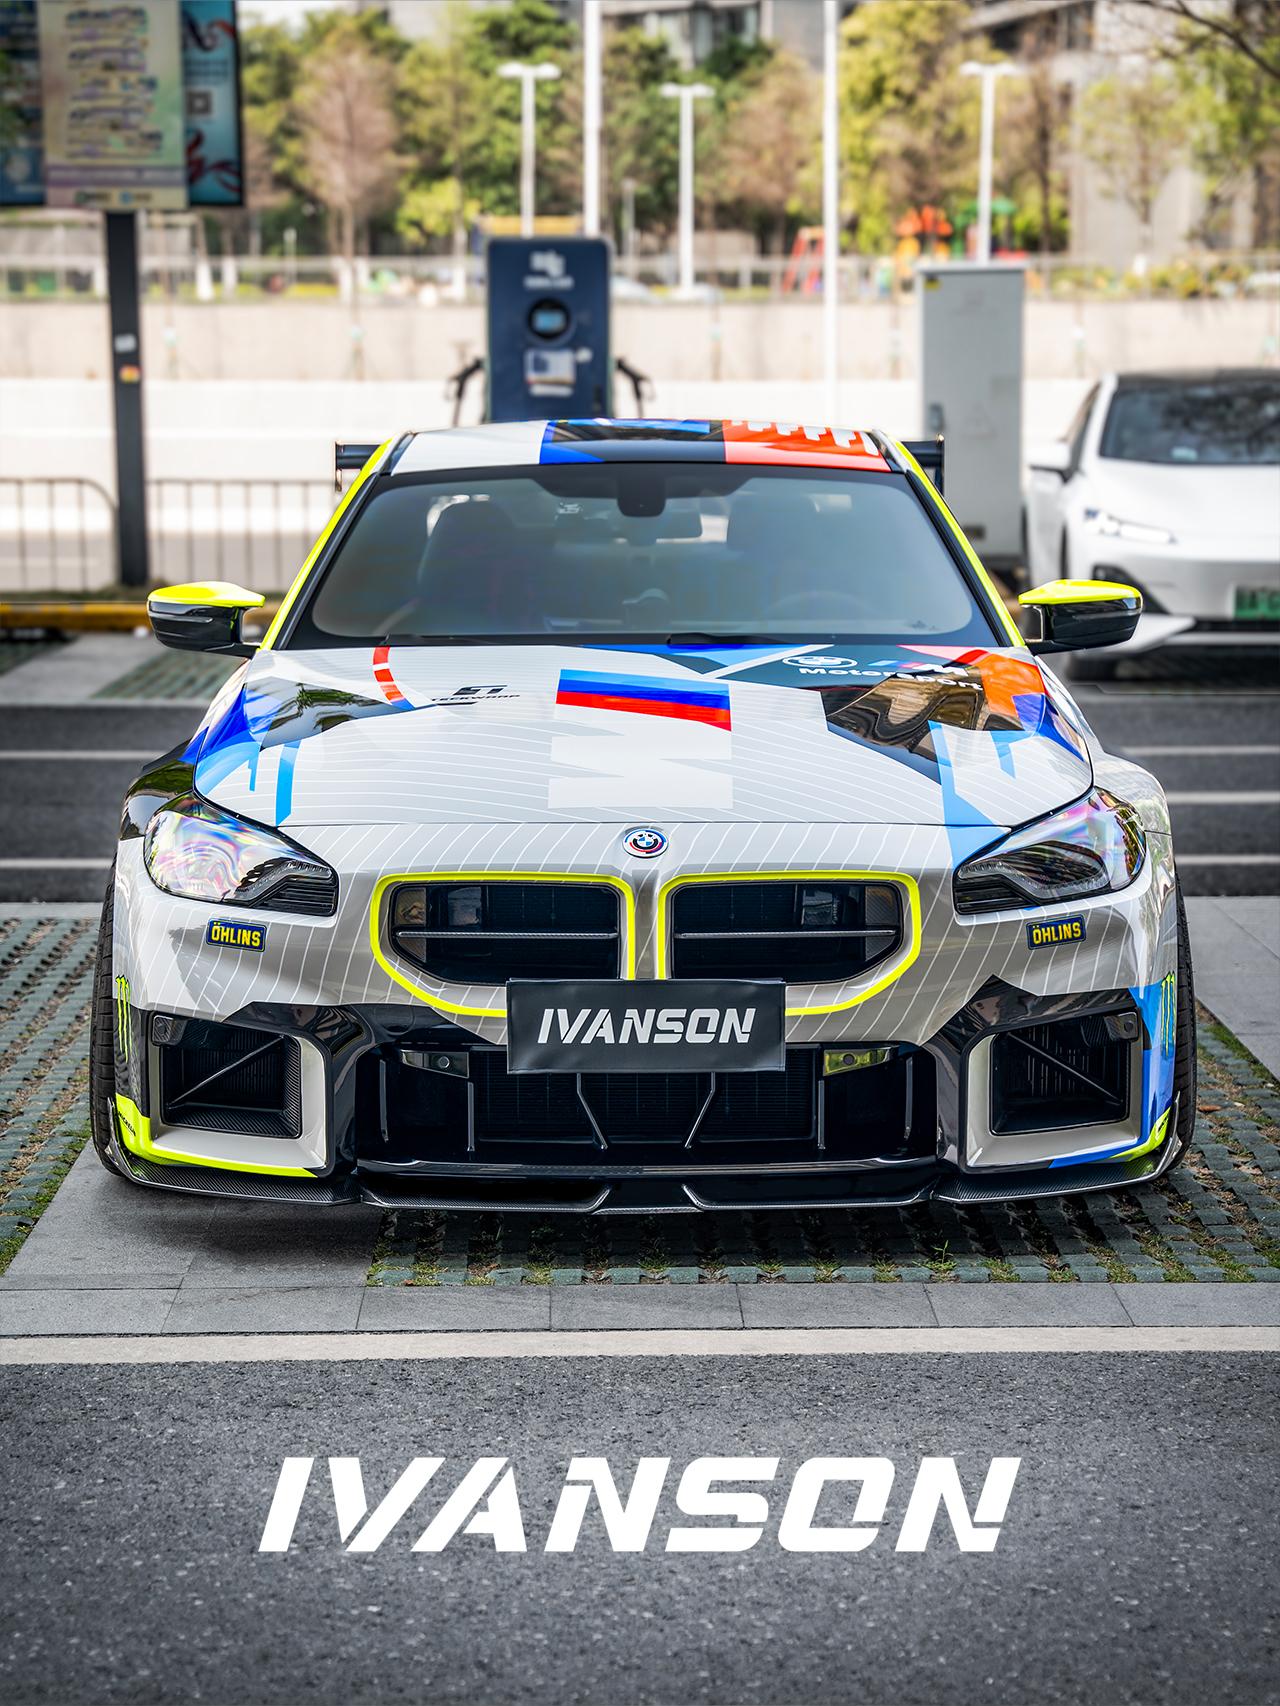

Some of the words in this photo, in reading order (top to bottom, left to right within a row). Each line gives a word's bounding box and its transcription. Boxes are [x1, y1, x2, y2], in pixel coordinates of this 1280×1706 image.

[799, 667, 983, 691] Motorsport
[211, 921, 262, 947] ÖHLINS
[1032, 921, 1082, 945] ÖHLINS
[537, 1008, 756, 1044] IVANSON
